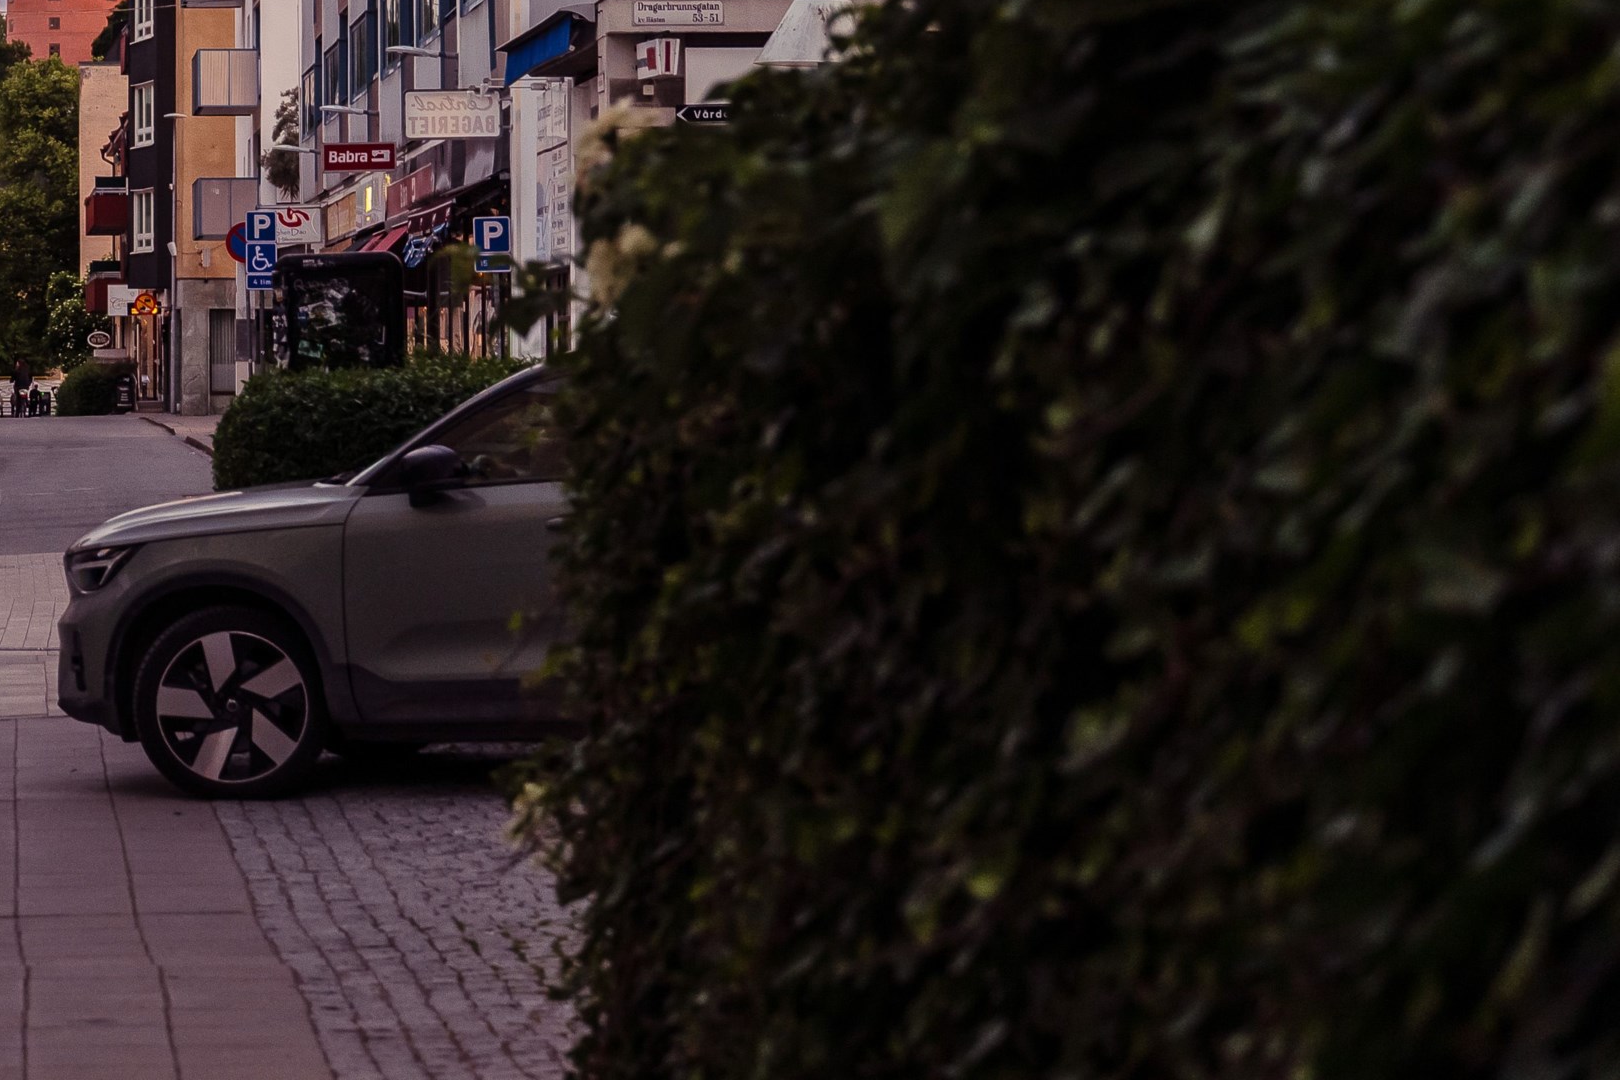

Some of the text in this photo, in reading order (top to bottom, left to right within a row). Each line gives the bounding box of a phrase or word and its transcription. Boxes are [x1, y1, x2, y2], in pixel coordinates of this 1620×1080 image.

[637, 2, 720, 13] Dragarbrunnsgatan
[328, 150, 368, 163] Babra
[254, 214, 271, 239] P
[483, 221, 503, 250] P
